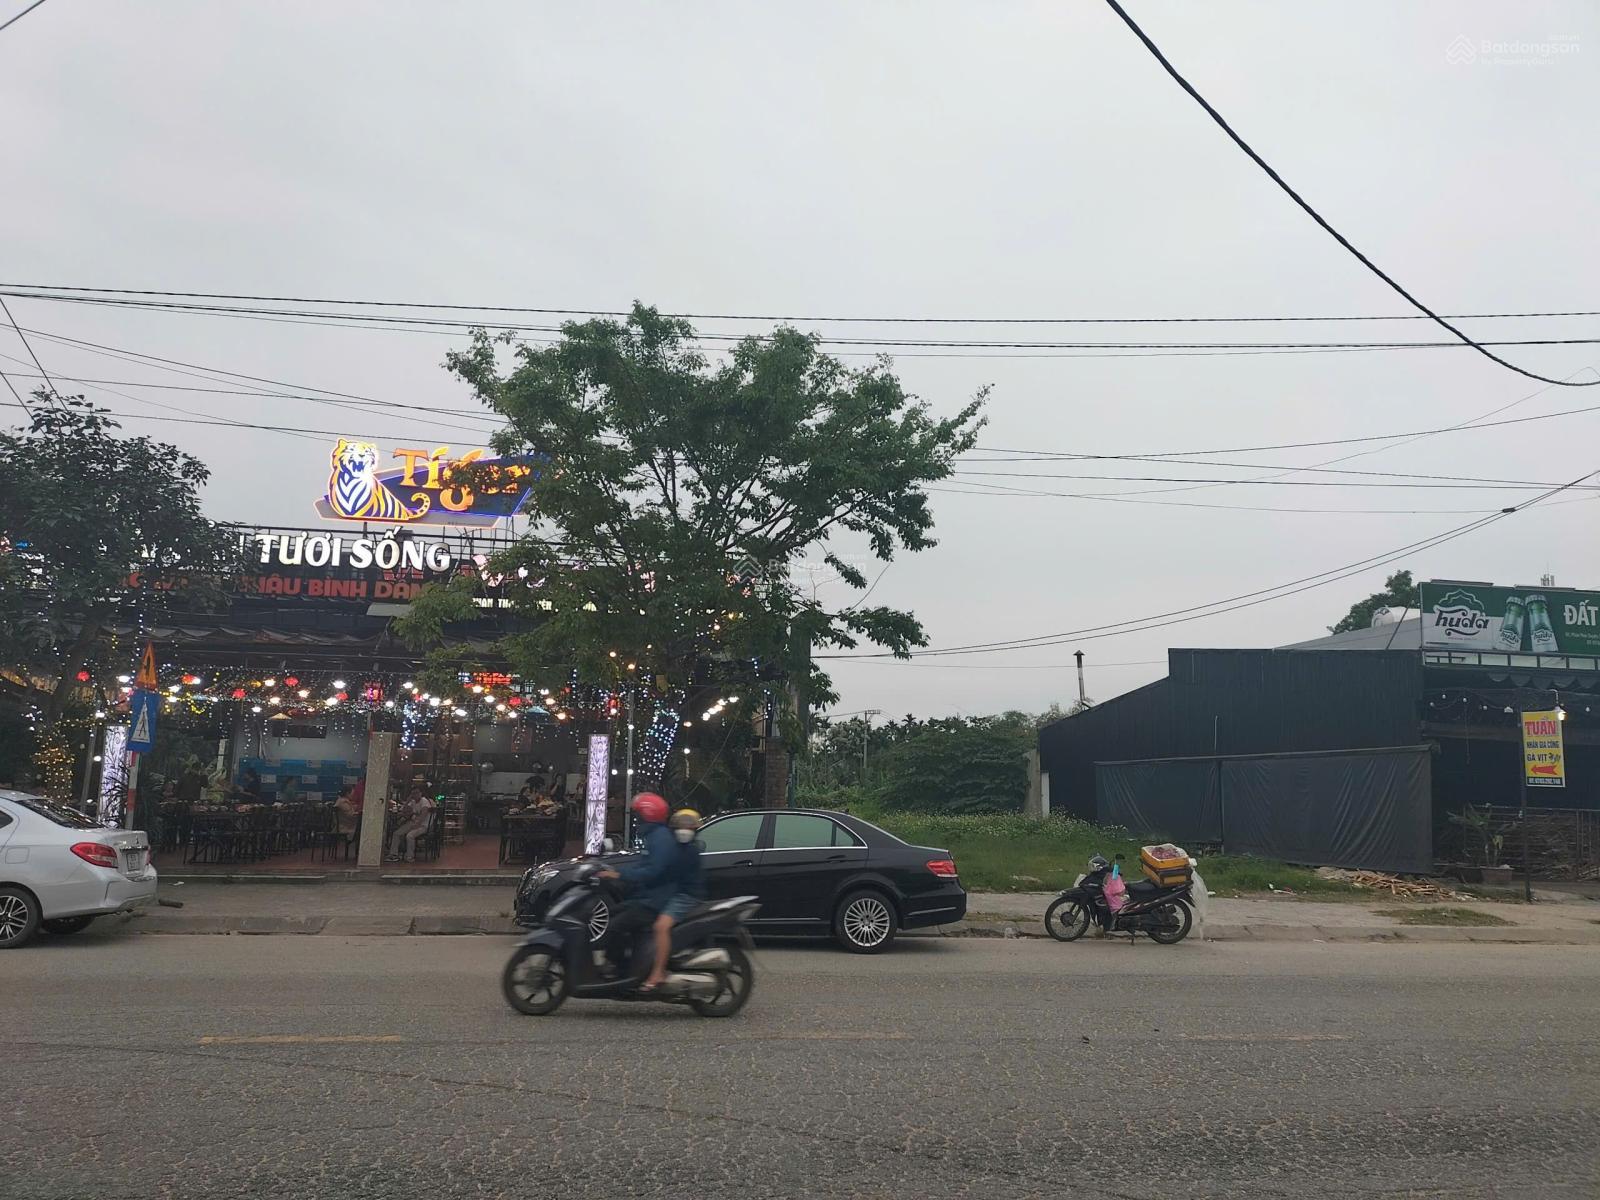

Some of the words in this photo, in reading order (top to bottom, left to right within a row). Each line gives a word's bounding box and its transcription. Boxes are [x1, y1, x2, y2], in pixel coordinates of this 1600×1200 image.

[255, 531, 342, 566] TƯƠI
[350, 526, 451, 572] SỐNG
[308, 576, 367, 598] BÌNH
[1435, 606, 1490, 631] huda
[1563, 600, 1598, 626] ĐẤT
